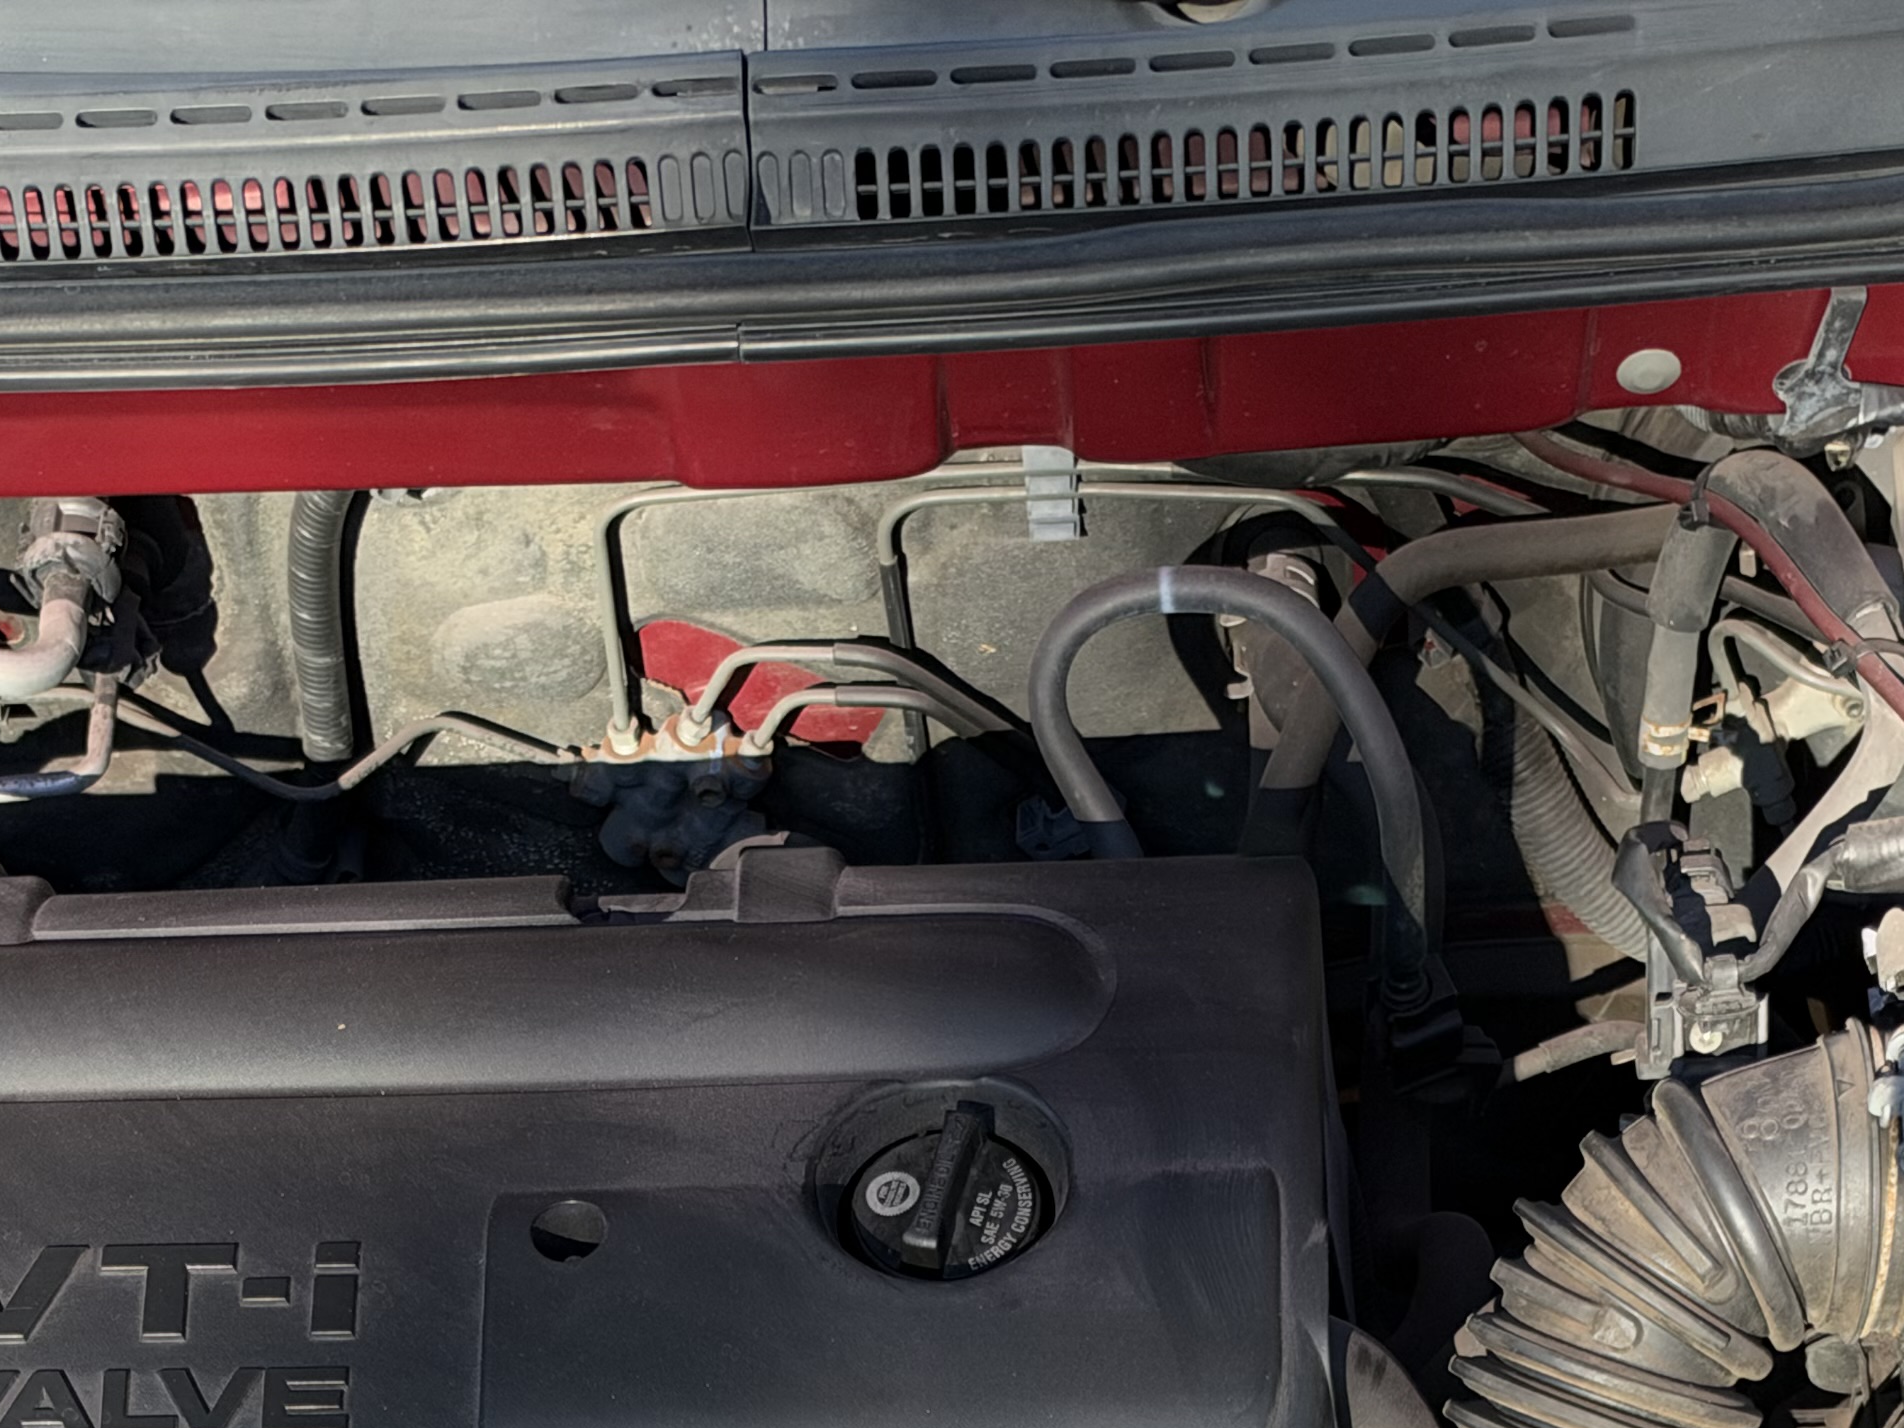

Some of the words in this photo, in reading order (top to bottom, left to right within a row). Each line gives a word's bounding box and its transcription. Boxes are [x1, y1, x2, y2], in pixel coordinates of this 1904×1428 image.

[977, 1190, 993, 1206] SL
[990, 1184, 1013, 1220] 5W-30
[967, 1232, 1017, 1271] ENERGY
[1002, 1158, 1032, 1233] CONSERVING
[969, 1210, 986, 1226] API
[981, 1222, 1000, 1245] SAE
